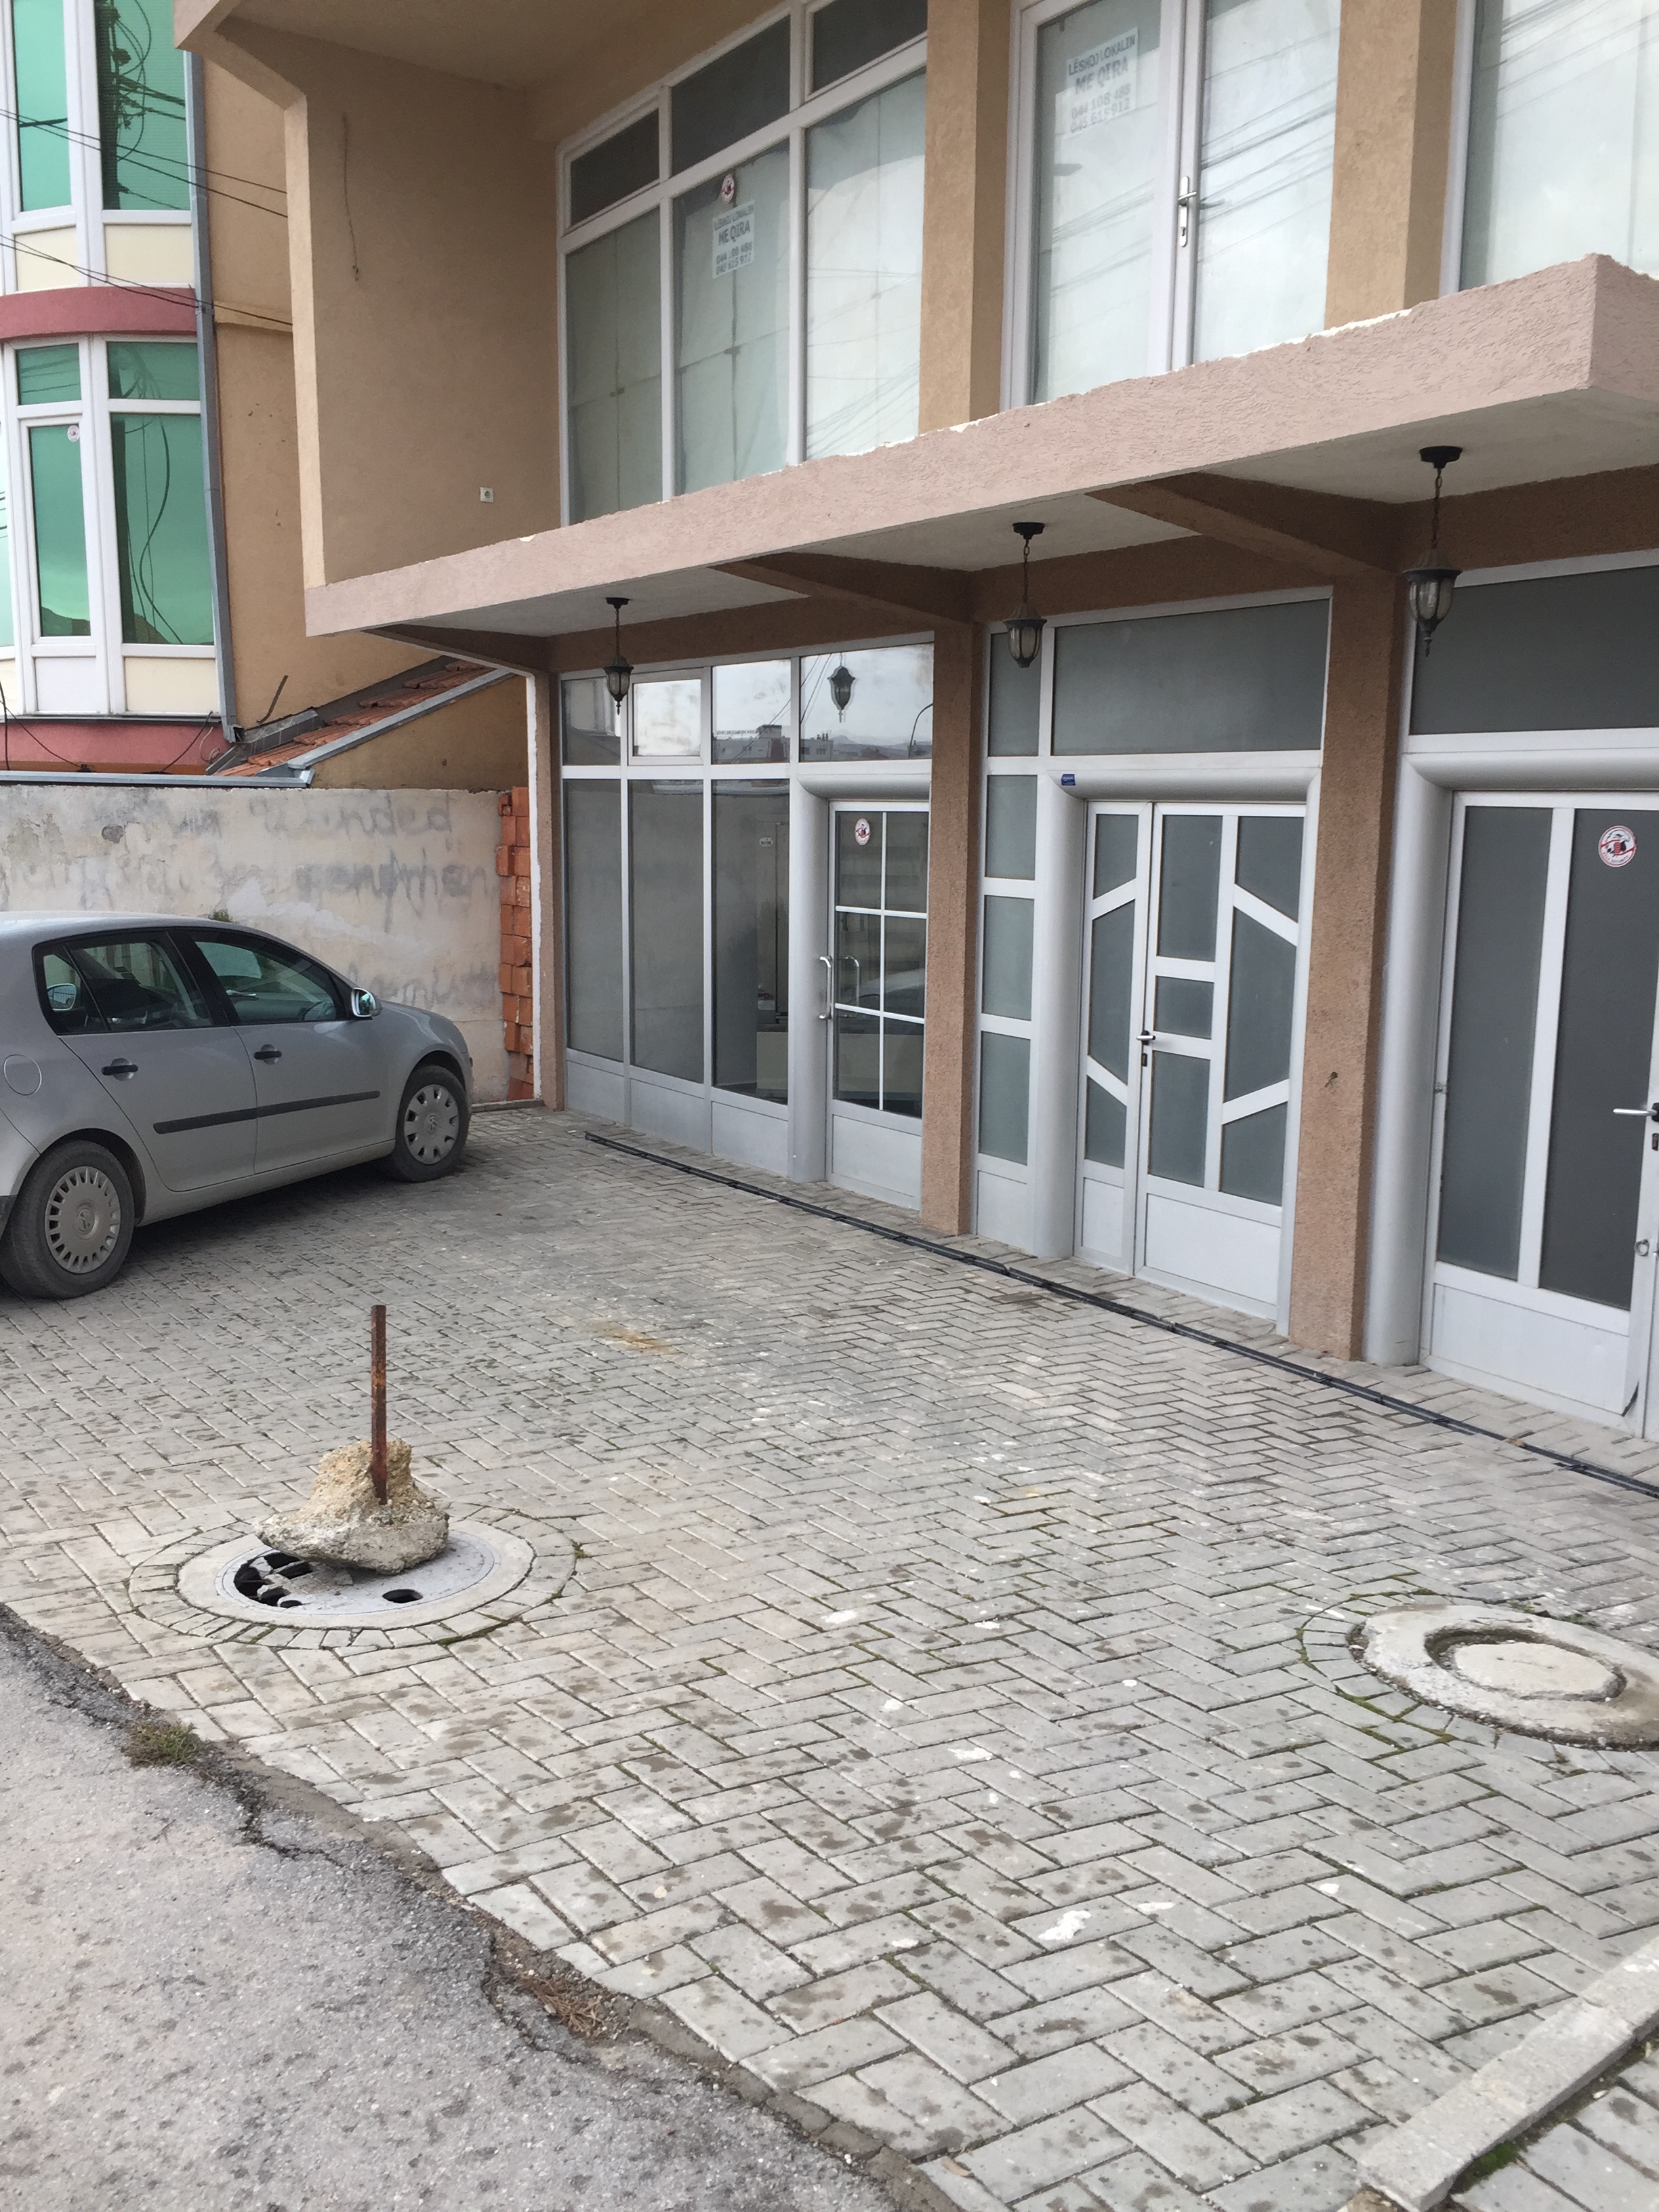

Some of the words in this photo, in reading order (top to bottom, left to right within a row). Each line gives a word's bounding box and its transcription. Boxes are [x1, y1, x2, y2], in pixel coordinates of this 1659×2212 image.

[1076, 72, 1094, 94] ME
[1097, 56, 1128, 87] QIRA
[718, 228, 729, 245] ME
[730, 220, 751, 242] QIRA
